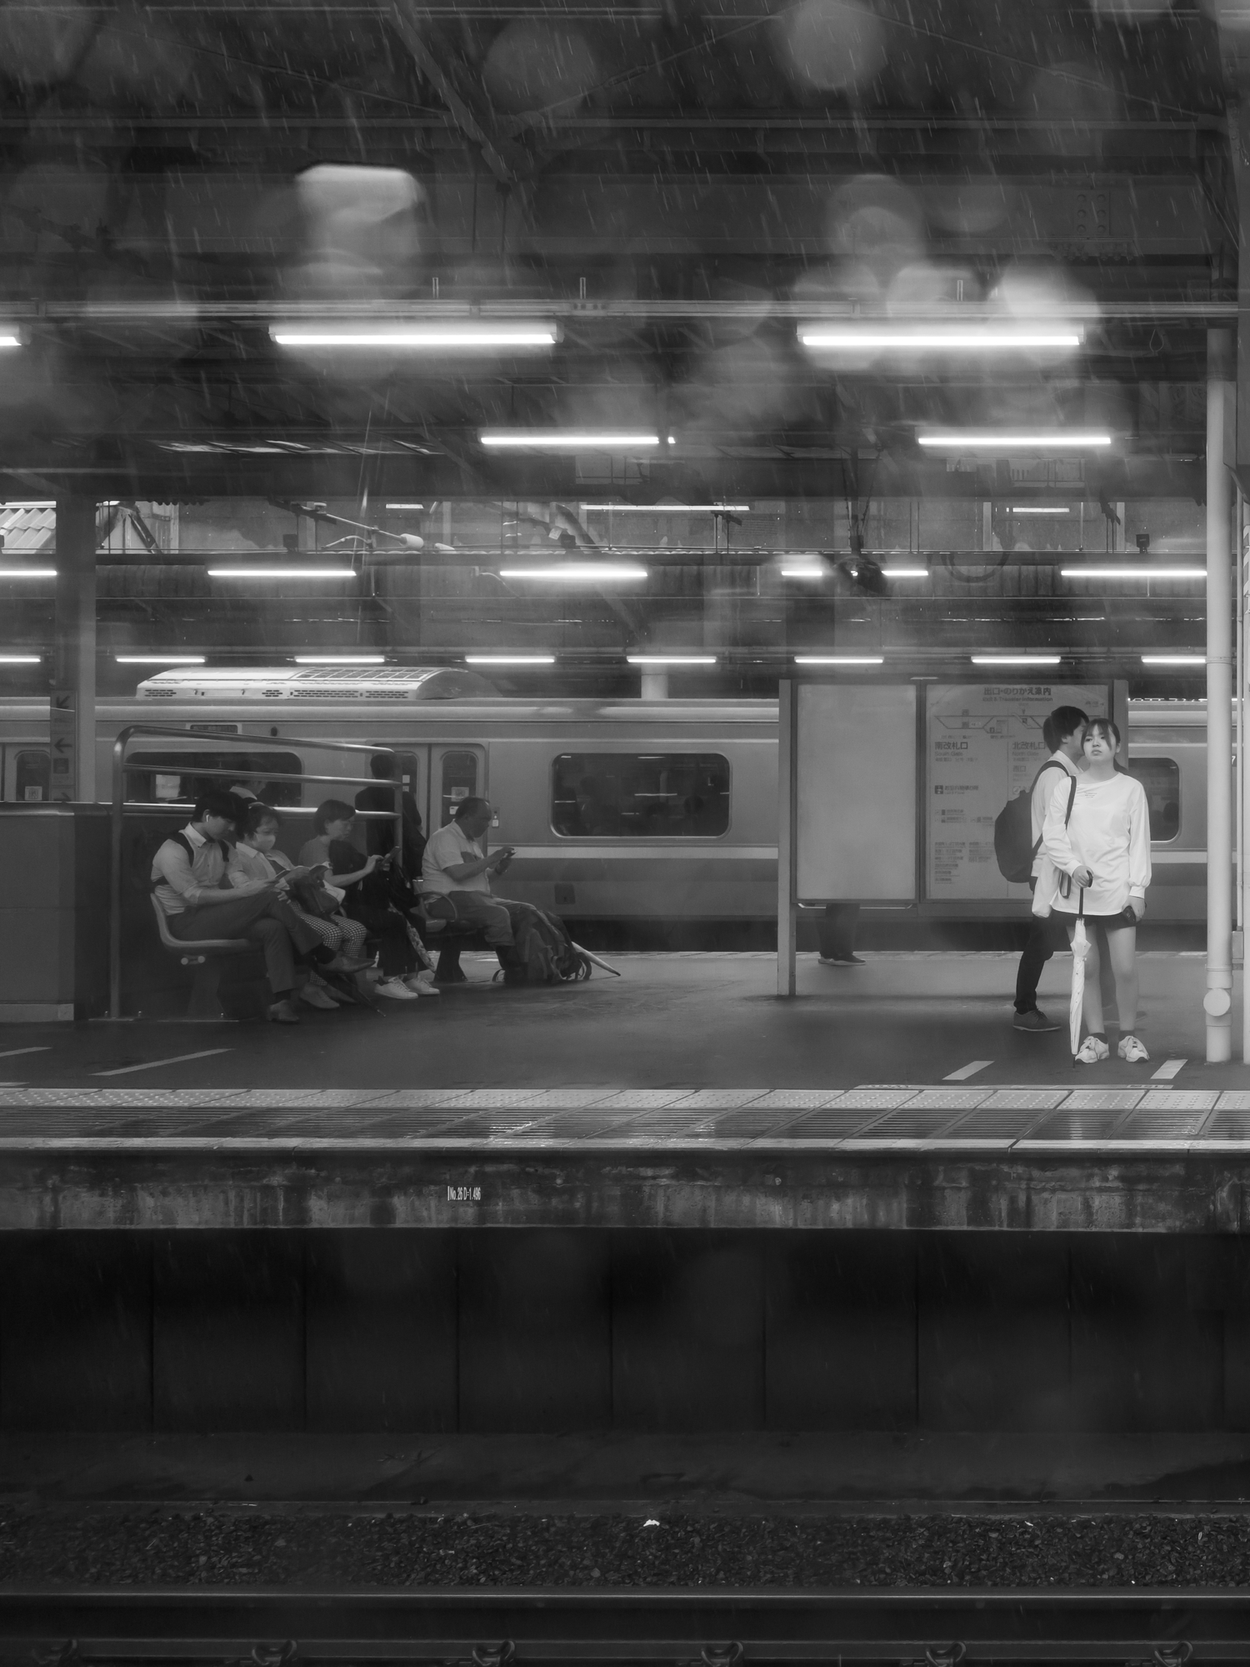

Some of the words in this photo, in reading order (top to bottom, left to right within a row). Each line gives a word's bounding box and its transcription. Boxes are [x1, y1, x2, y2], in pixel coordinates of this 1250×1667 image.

[934, 741, 969, 750] 南改札口
[1012, 741, 1046, 750] 北改札口
